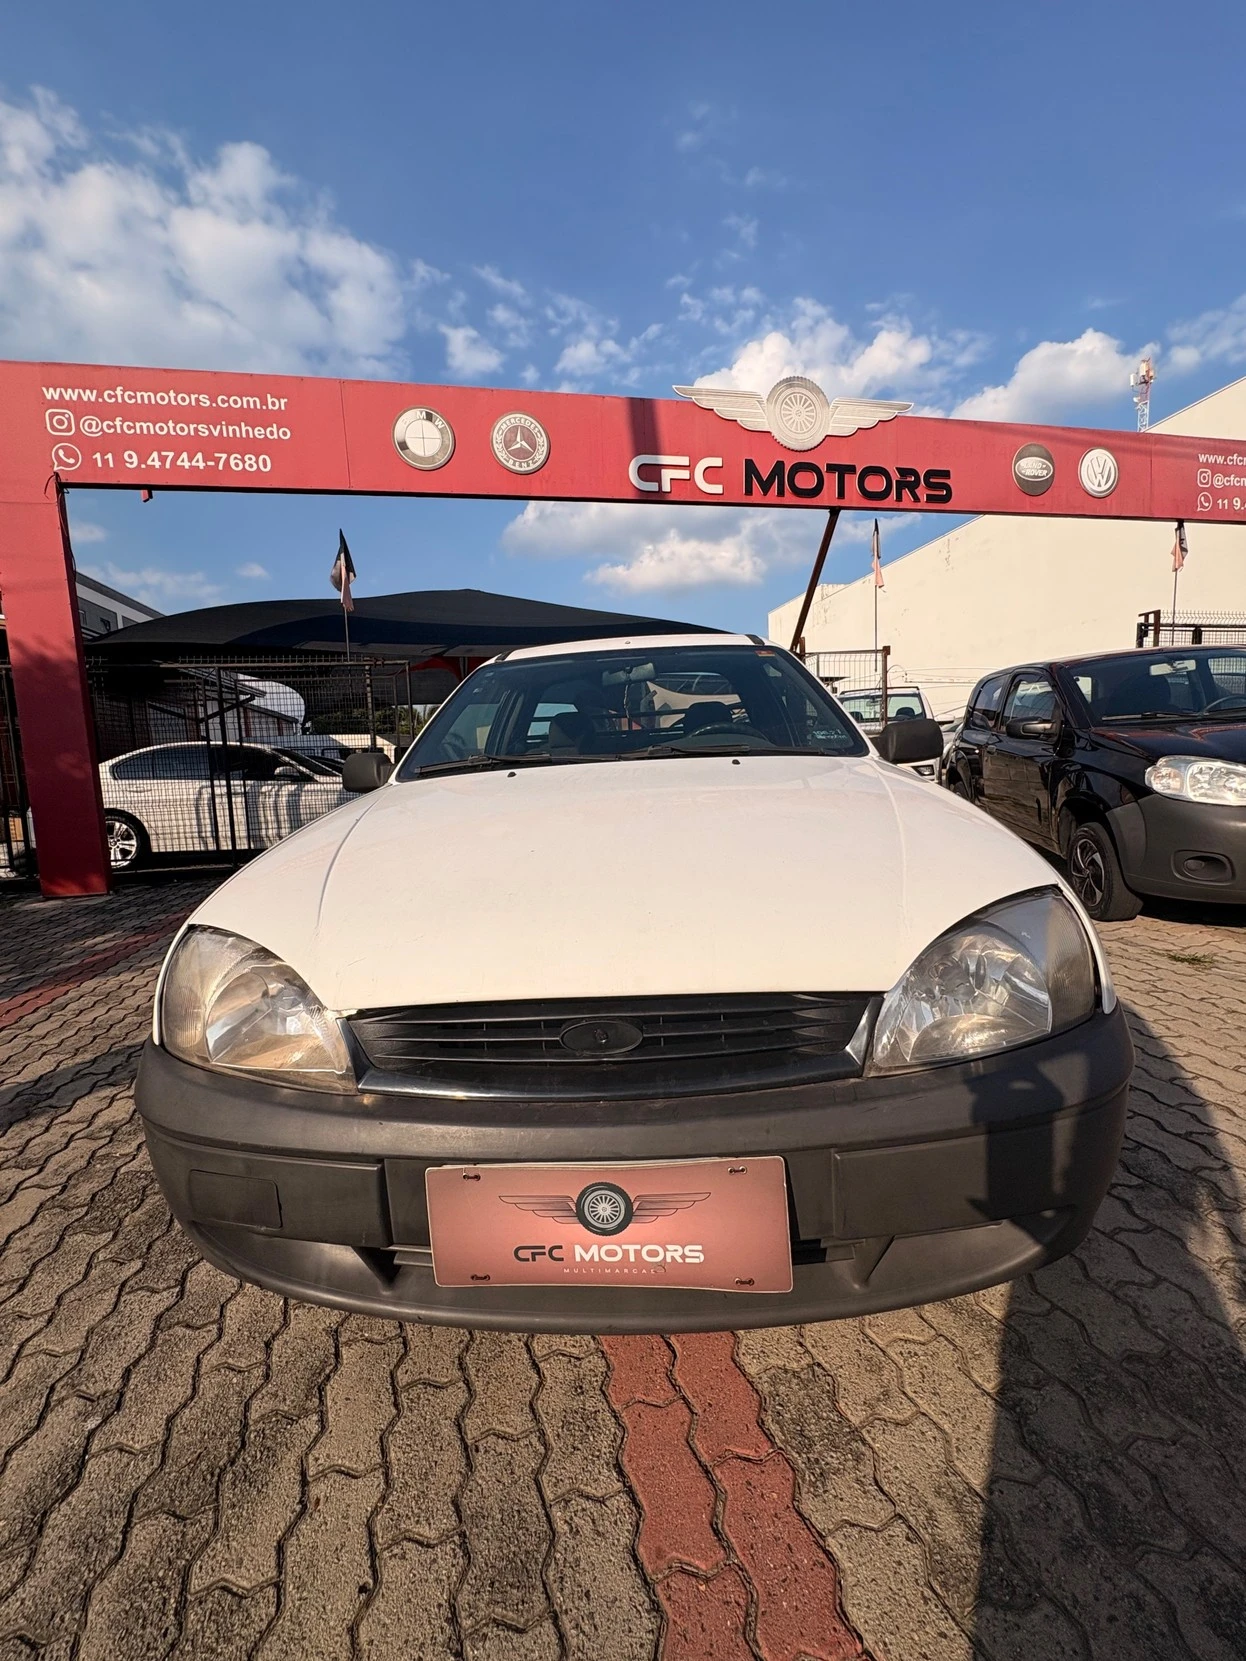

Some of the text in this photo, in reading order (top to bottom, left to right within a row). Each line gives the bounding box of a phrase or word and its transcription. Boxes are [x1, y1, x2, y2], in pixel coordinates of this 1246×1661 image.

[41, 386, 288, 411] www.cfcmotors.com.br
[79, 416, 292, 440] @cfcmotorsvinhedo
[400, 411, 446, 429] BMW
[500, 417, 540, 434] MERCEDES
[92, 450, 272, 473] 11 9.4744-7680
[507, 459, 534, 469] BENZ
[1198, 453, 1246, 466] www.cfc
[628, 454, 953, 504] CFC MOTORS
[1025, 469, 1048, 477] ROVER
[1216, 497, 1246, 511] 11 9.
[513, 1244, 705, 1264] CFC MOTORS
